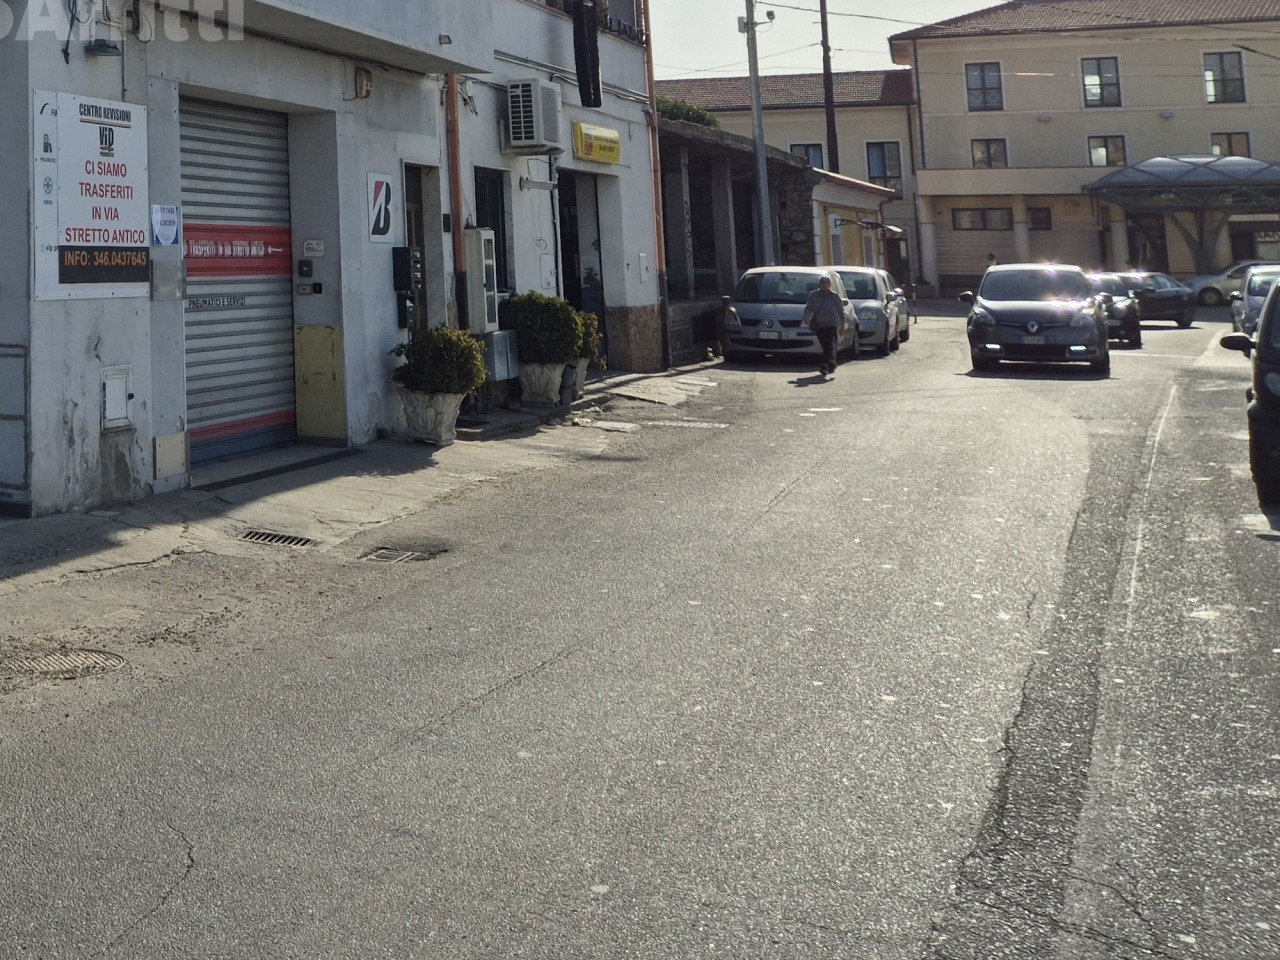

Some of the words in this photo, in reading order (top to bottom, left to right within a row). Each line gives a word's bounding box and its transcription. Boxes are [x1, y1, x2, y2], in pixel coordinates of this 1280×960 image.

[79, 103, 102, 119] CENTRO
[103, 107, 131, 122] REVISIONI
[85, 160, 94, 175] CI
[97, 161, 127, 178] SIAMO
[79, 182, 133, 199] TRASFERITI
[92, 206, 101, 220] IN
[104, 206, 120, 221] VIA
[65, 227, 110, 243] STRETTO
[111, 229, 145, 244] ANTICO
[64, 250, 91, 266] INFO:
[93, 251, 147, 266] 346.0437645
[188, 298, 220, 308] PNEUMATICI
